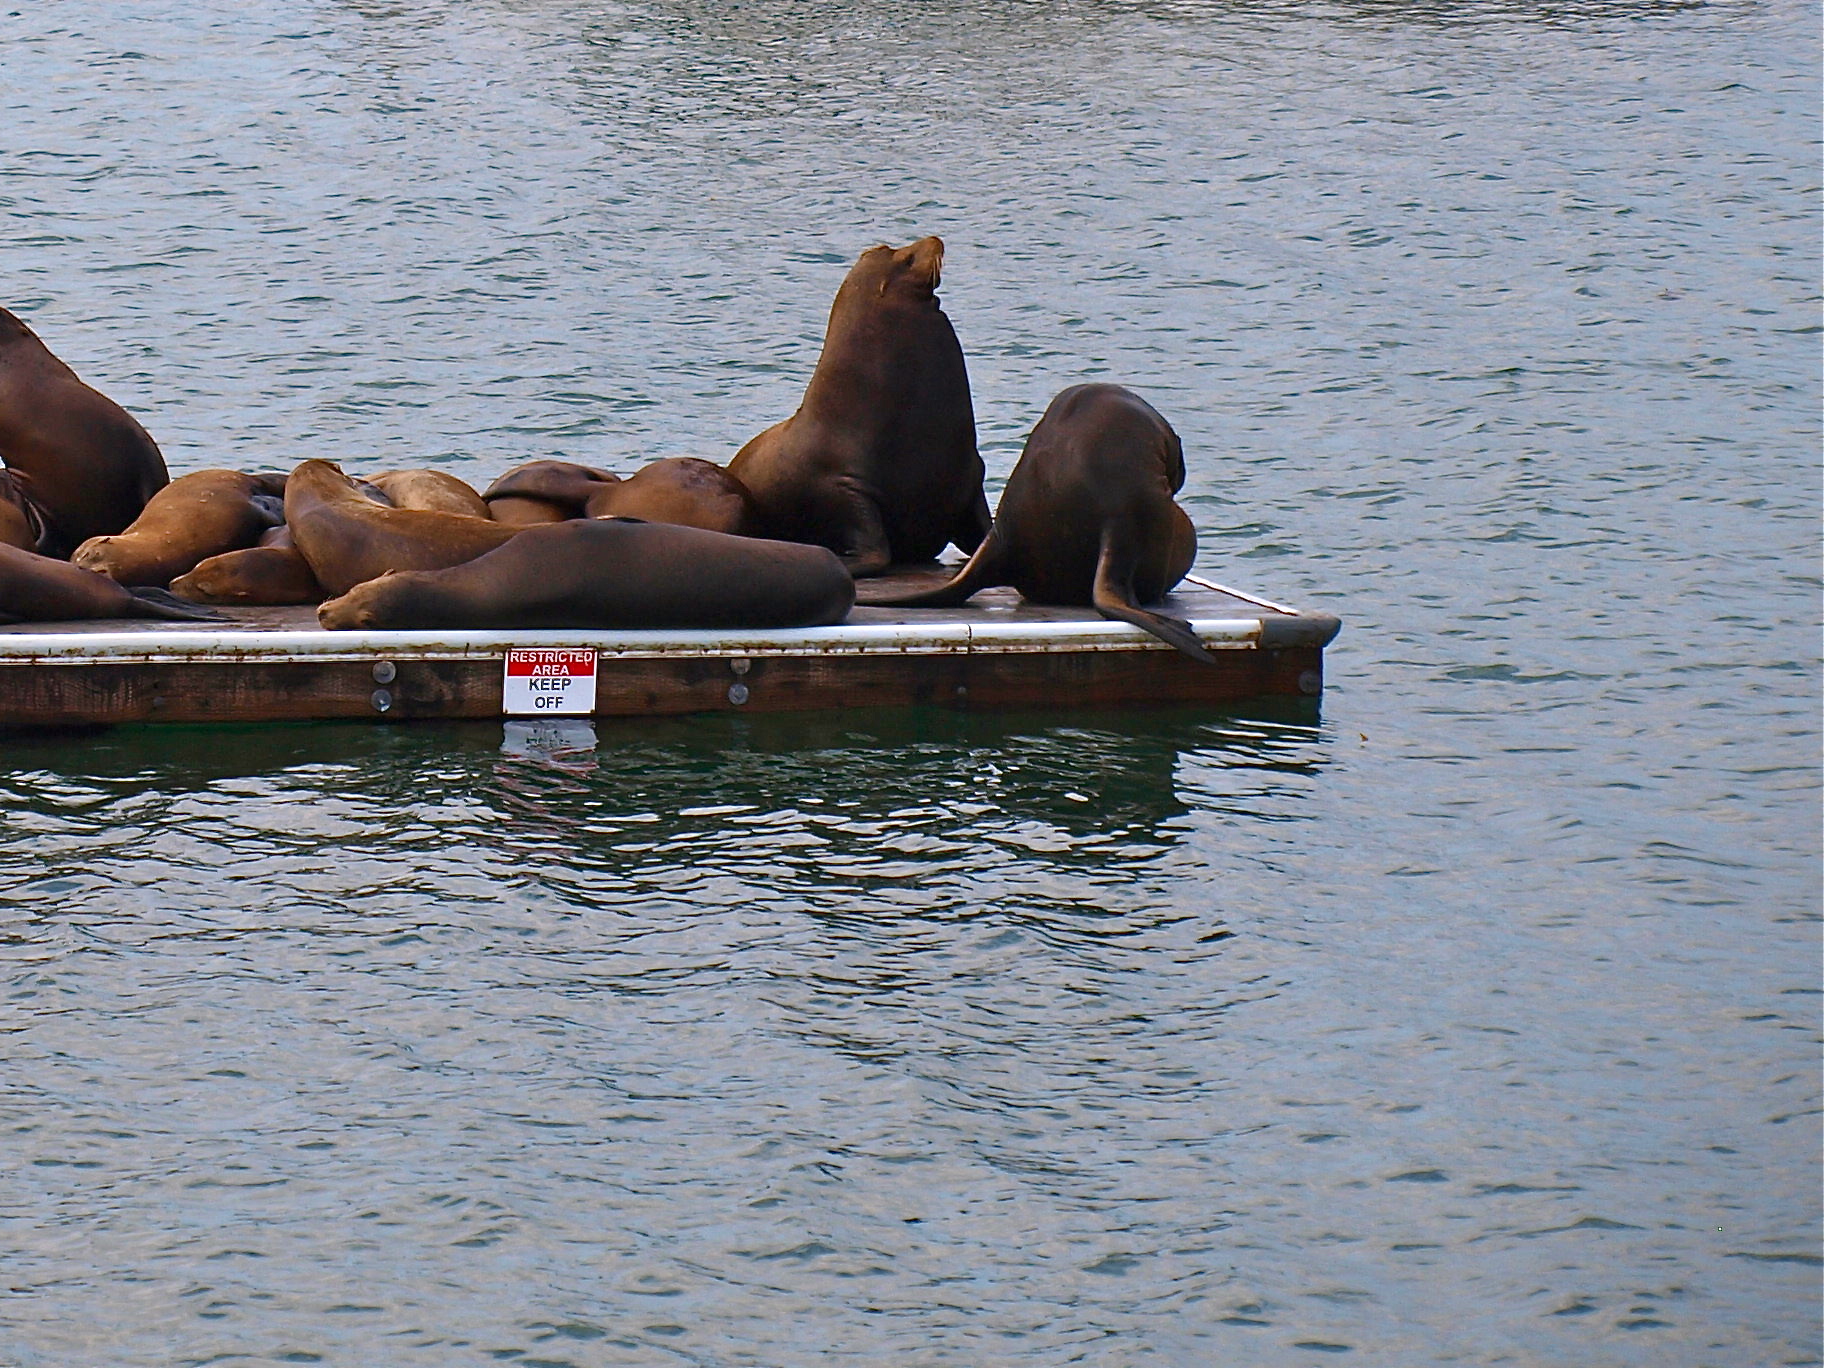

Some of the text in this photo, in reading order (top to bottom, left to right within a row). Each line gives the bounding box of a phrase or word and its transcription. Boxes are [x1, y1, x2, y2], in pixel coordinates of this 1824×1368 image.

[510, 651, 593, 663] RESTRICTED
[532, 664, 570, 676] AREA
[528, 678, 572, 691] KEEP
[534, 696, 564, 709] OFF
